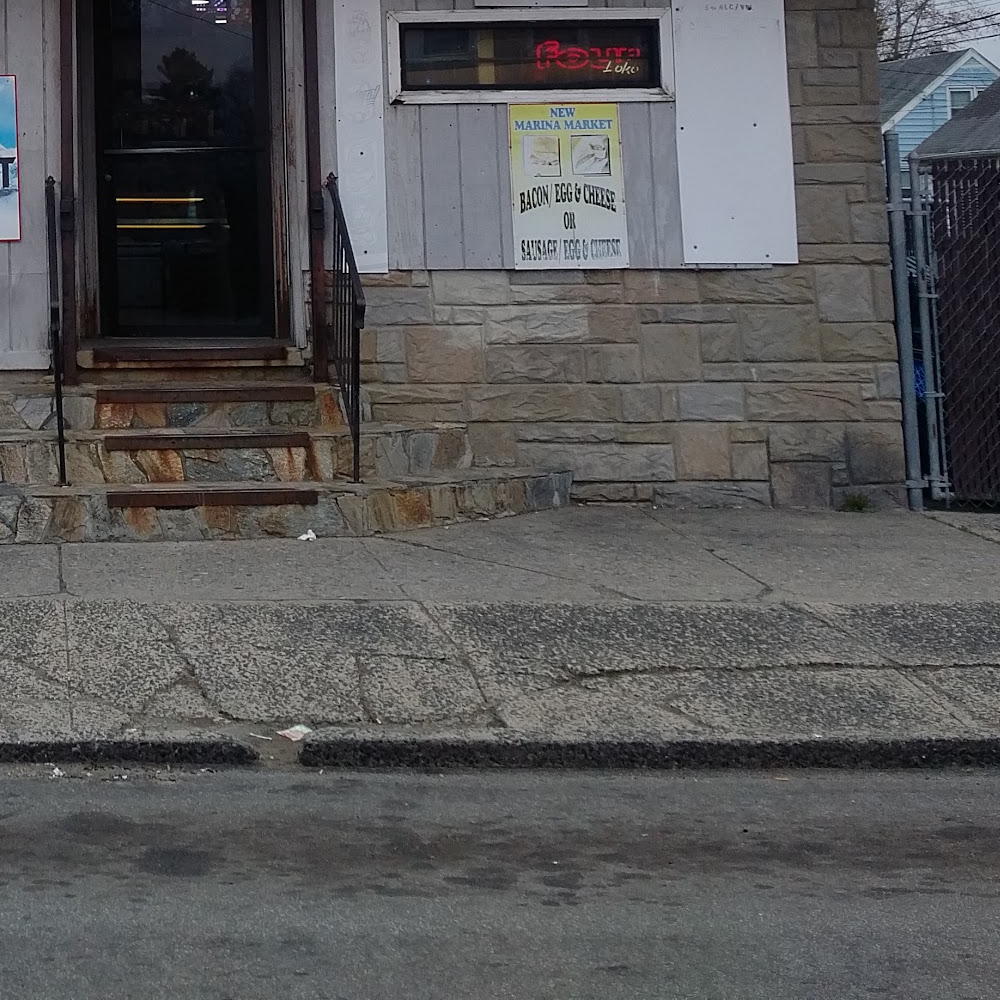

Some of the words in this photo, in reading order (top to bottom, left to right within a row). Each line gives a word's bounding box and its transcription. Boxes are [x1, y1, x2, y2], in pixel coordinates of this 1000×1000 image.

[603, 61, 639, 75] Loko
[550, 107, 576, 118] NEW
[514, 120, 561, 131] MARINA
[564, 119, 613, 130] MARKET
[555, 182, 573, 203] EGG
[574, 182, 581, 203] &
[583, 183, 617, 213] CHEESE
[563, 212, 576, 229] OR
[563, 239, 581, 260] EGG
[590, 238, 621, 261] CHEESE
